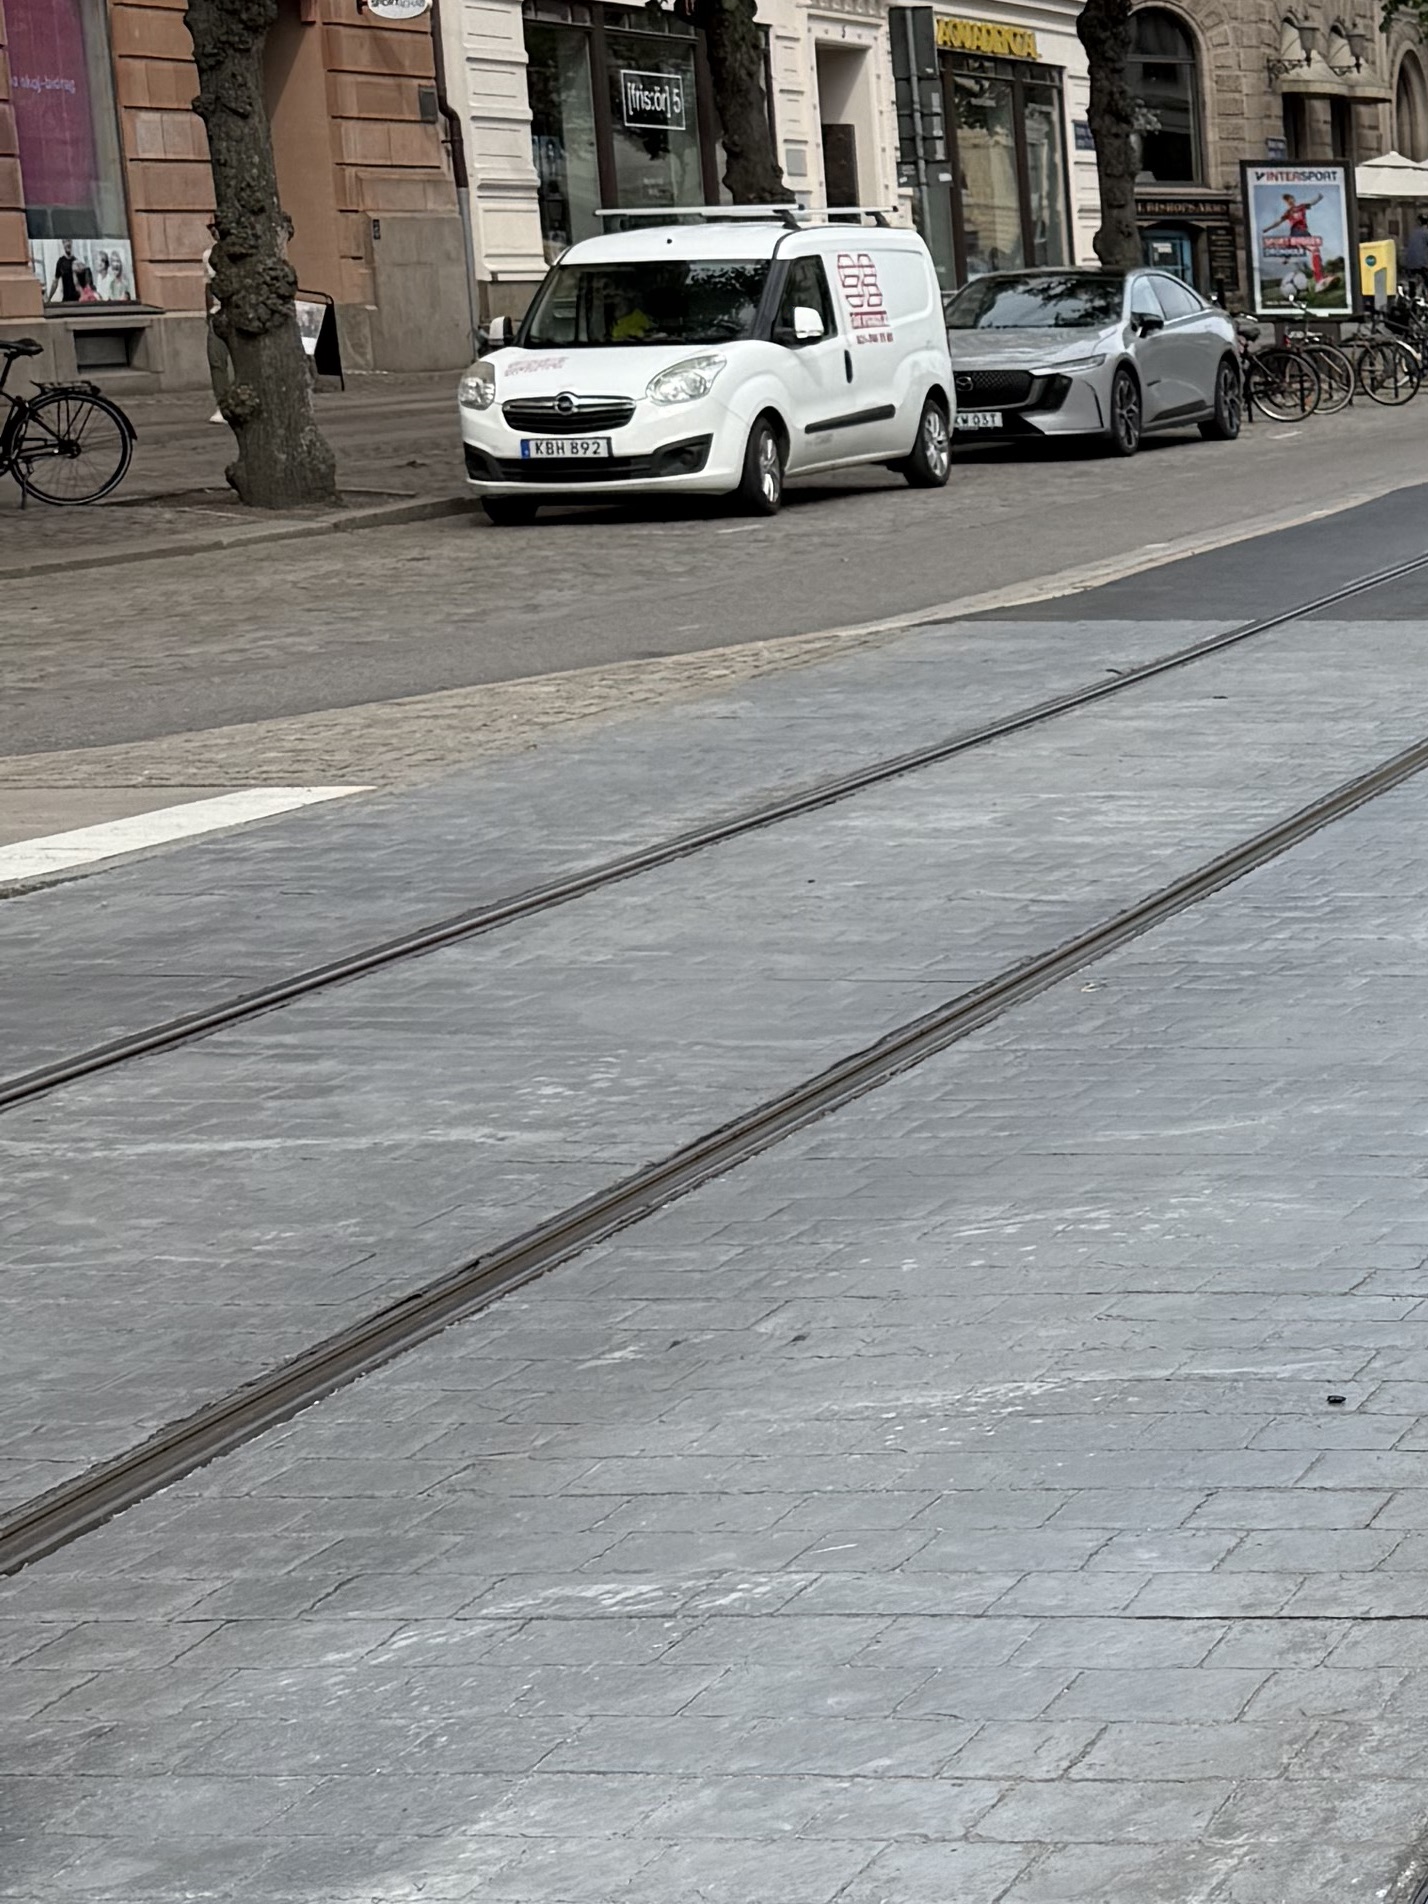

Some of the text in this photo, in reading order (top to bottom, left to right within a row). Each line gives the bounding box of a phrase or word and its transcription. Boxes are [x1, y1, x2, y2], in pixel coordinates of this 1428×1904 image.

[672, 88, 681, 113] 5
[535, 441, 601, 456] KBH 892
